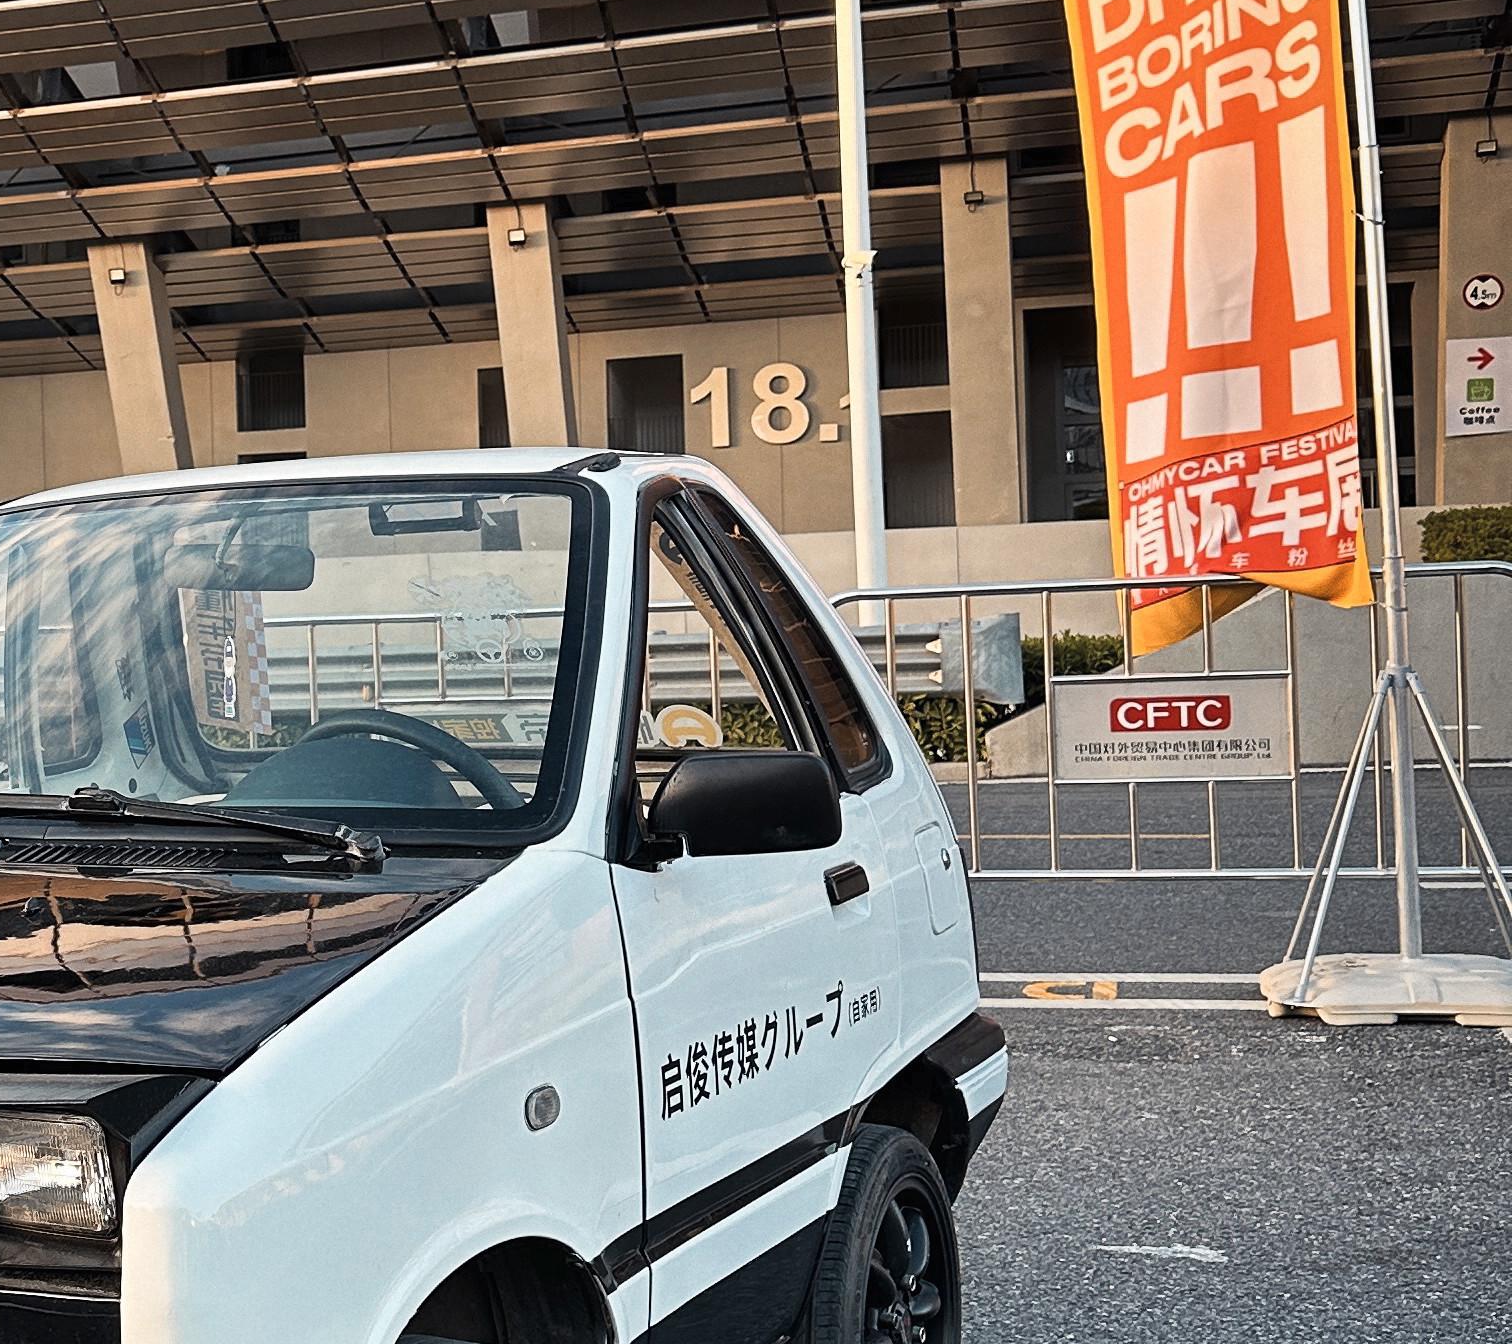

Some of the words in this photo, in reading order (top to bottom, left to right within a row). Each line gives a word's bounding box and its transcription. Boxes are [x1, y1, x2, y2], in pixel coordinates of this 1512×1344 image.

[1104, 19, 1322, 179] CARS
[1469, 285, 1497, 301] 4.5m
[690, 361, 850, 449] 18.
[1459, 406, 1501, 416] Coffee
[1128, 452, 1246, 502] OHMYCAR
[1116, 699, 1223, 730] CFTC
[661, 980, 844, 1121] 启俊传媒グループ
